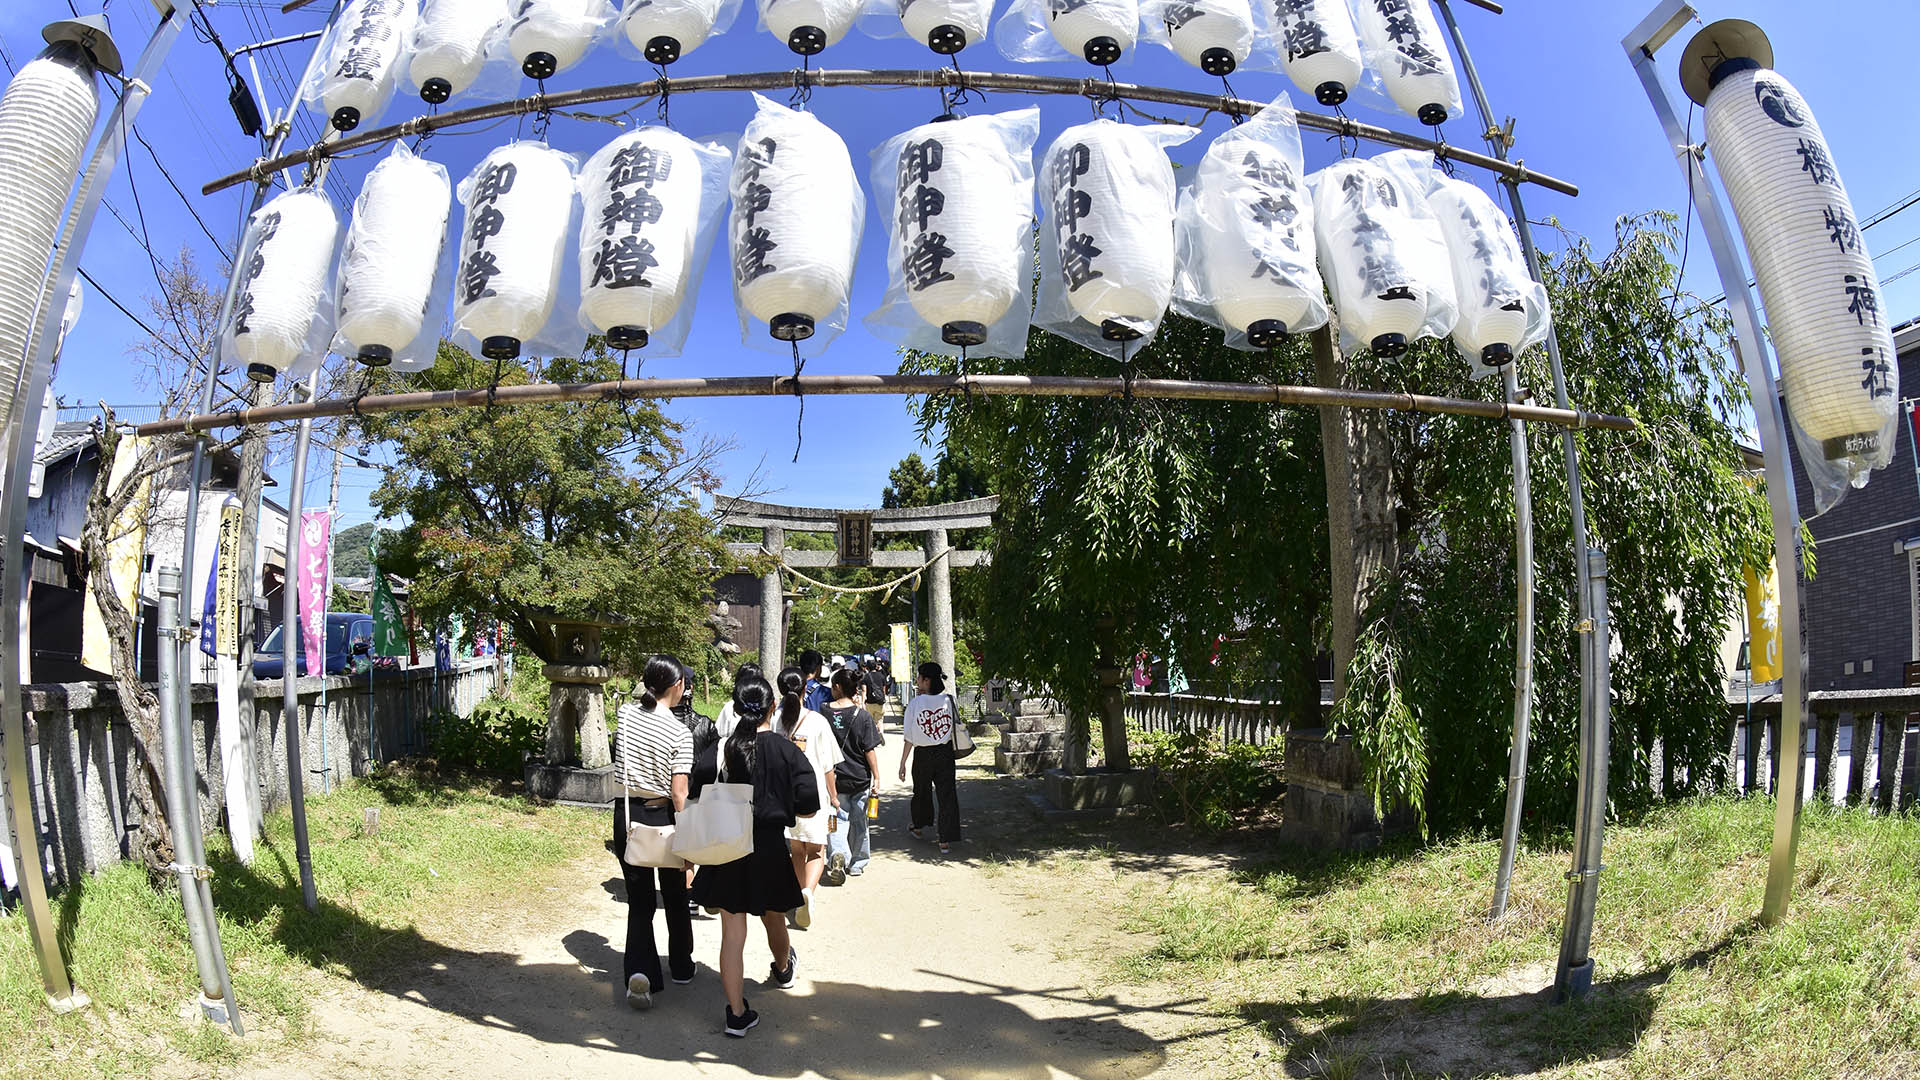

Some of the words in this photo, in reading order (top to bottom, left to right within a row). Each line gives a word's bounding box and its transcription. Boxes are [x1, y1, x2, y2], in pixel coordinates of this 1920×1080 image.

[590, 141, 672, 289] 御神燈
[897, 138, 956, 292] 御神燈
[1052, 143, 1103, 292] 御神燈
[1797, 137, 1893, 400] 機物神社
[231, 604, 236, 619] On
[918, 710, 930, 723] Be
